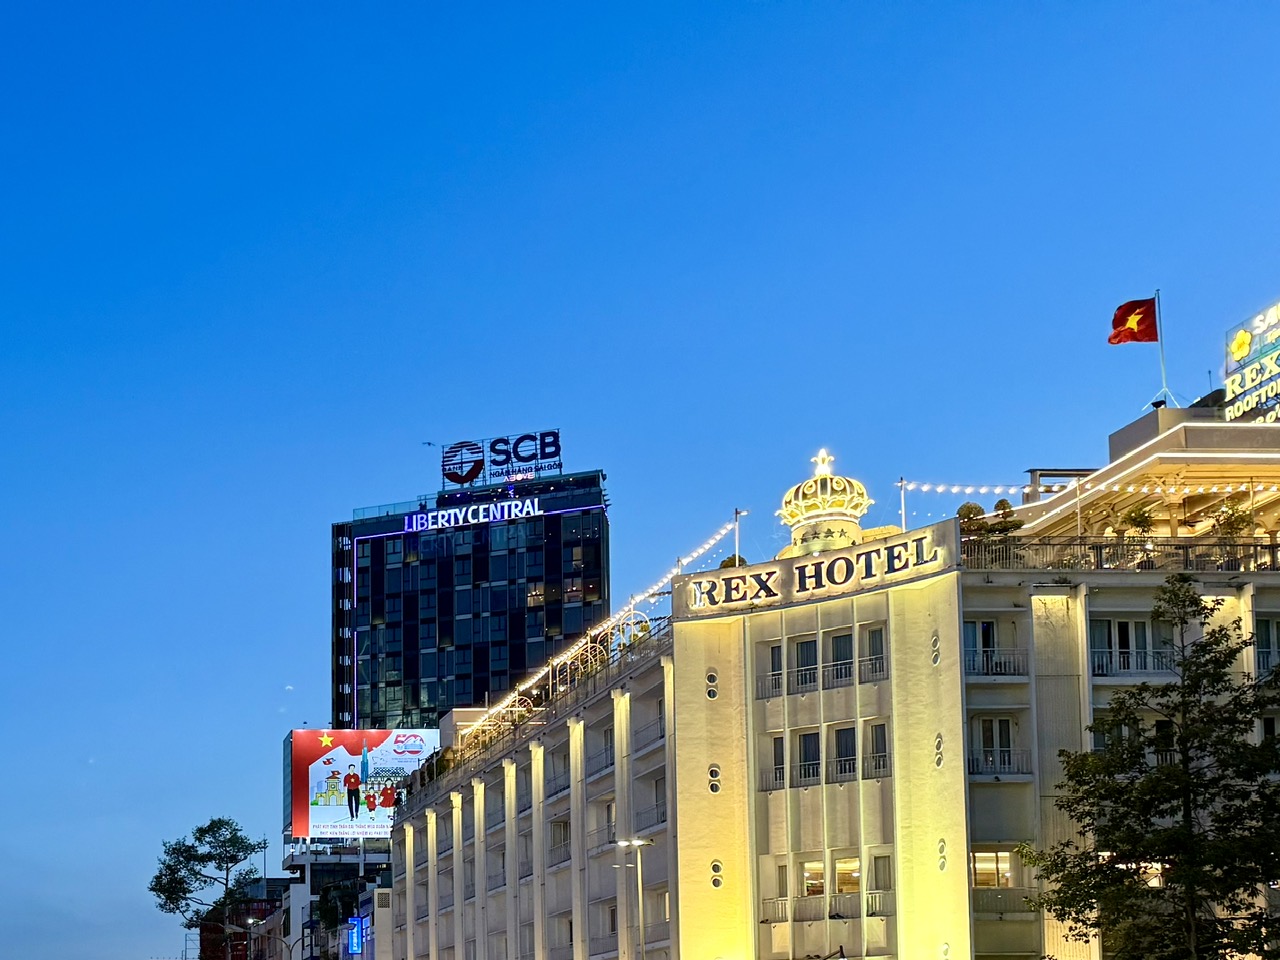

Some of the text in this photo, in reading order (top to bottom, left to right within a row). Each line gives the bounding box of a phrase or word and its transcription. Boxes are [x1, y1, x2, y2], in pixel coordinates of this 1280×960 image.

[1224, 380, 1280, 422] ROOFTO
[489, 431, 561, 466] SCB
[405, 498, 544, 532] LIBERTY CENTRAL
[690, 536, 939, 608] REX HOTEL
